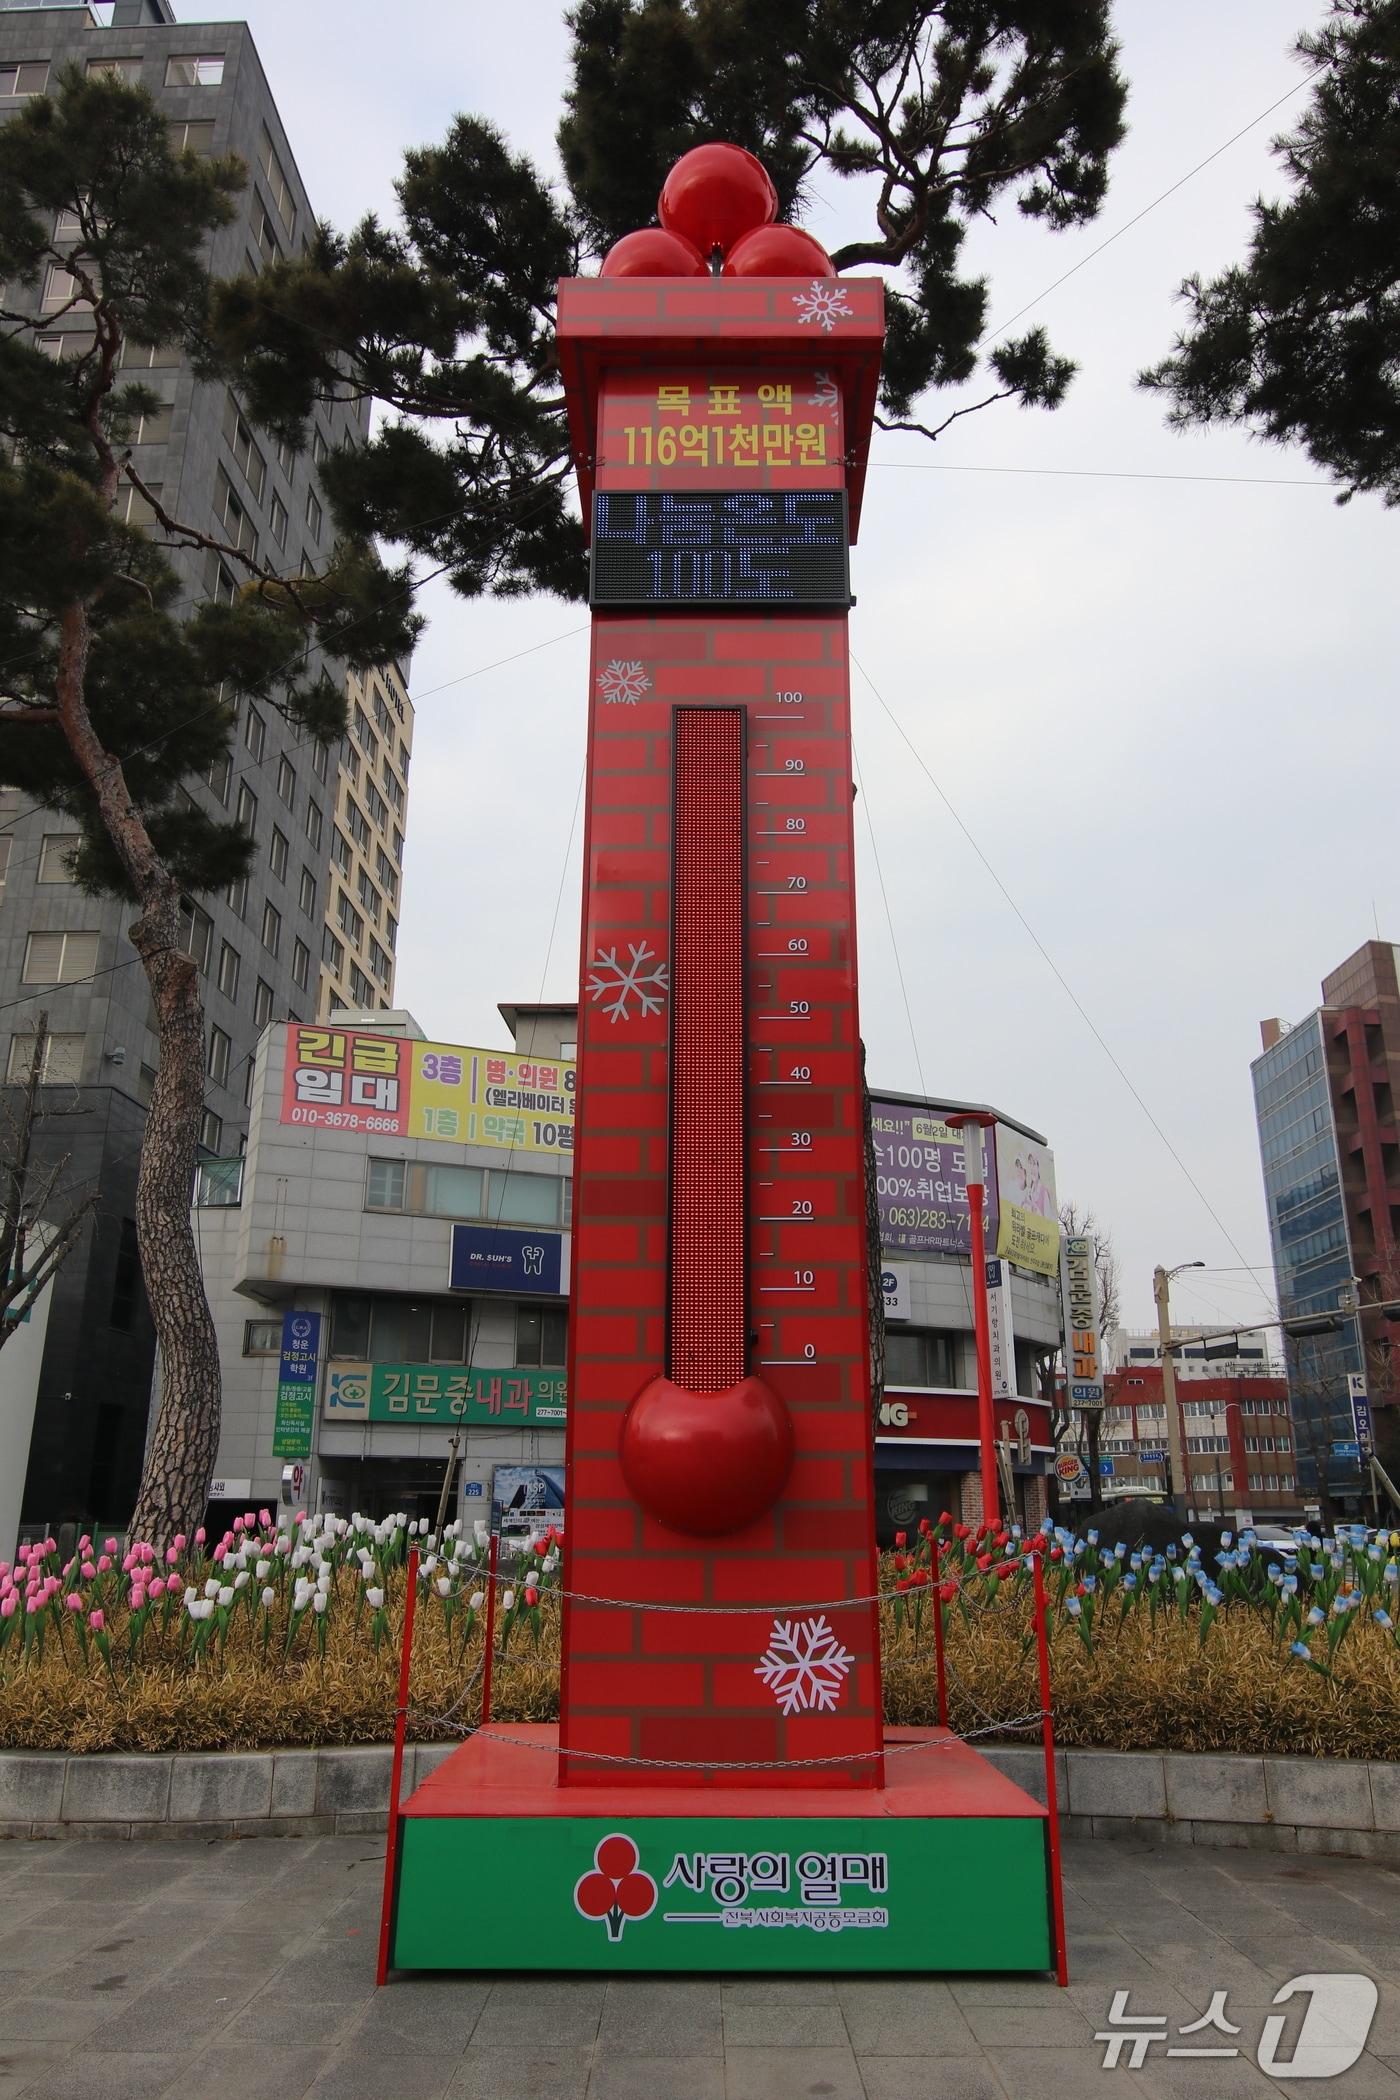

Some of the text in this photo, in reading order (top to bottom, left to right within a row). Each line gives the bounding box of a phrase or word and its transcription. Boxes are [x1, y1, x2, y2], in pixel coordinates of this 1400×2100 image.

[623, 423, 827, 467] 116억1천만원
[597, 494, 839, 544] 나눔온도
[646, 547, 794, 597] 100도
[775, 691, 803, 703] 100
[785, 759, 804, 771] 90
[786, 818, 805, 830] 80
[787, 877, 807, 889] 70
[788, 938, 808, 951] 60
[789, 1001, 809, 1014] 50
[298, 1030, 399, 1075] 긴급
[422, 1053, 462, 1086] 3층
[790, 1067, 811, 1080] 40
[295, 1068, 399, 1112] 임대
[292, 1108, 399, 1132] 010-3678-6666
[423, 1107, 459, 1137] 1층
[483, 1115, 526, 1146] 약국
[915, 1123, 948, 1139] 6월2일
[791, 1133, 811, 1146] 30
[792, 1201, 812, 1214] 20
[470, 1253, 513, 1263] DR. SUH'S
[793, 1271, 814, 1284] 10
[882, 1278, 895, 1287] 2F
[292, 1340, 309, 1350] 청운
[804, 1344, 815, 1358] 0
[282, 1351, 316, 1363] 검정고시
[290, 1363, 307, 1374] 학원
[280, 1391, 312, 1402] 검정고시
[1073, 1385, 1101, 1398] 의원
[1060, 1464, 1079, 1475] KING
[666, 1855, 886, 1903] 사랑의 열매
[756, 1909, 887, 1929] 사회복지공동모금회
